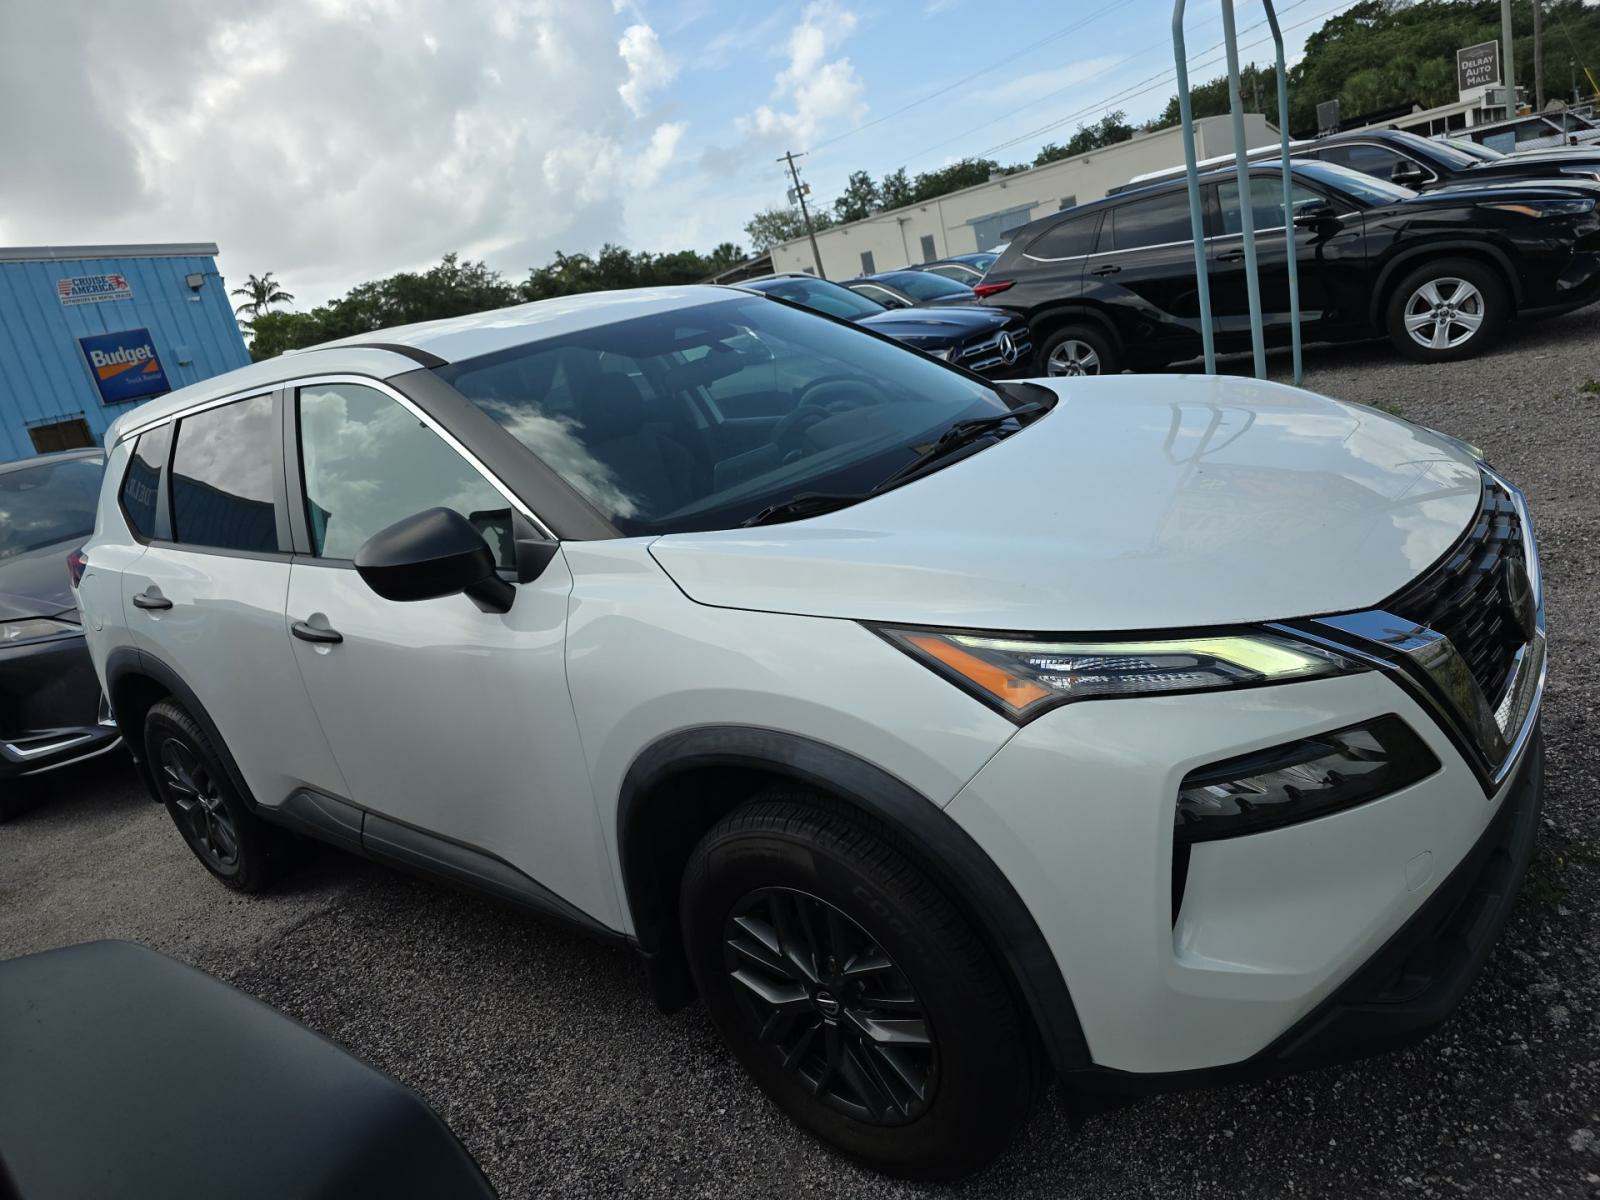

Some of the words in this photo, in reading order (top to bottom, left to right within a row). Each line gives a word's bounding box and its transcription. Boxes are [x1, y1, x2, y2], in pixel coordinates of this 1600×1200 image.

[1461, 56, 1493, 70] DELRAY
[1466, 65, 1491, 77] AUTO
[1467, 75, 1490, 86] MALL
[71, 276, 108, 287] CRUISE
[71, 283, 116, 295] AMERICA
[90, 344, 154, 368] Budget
